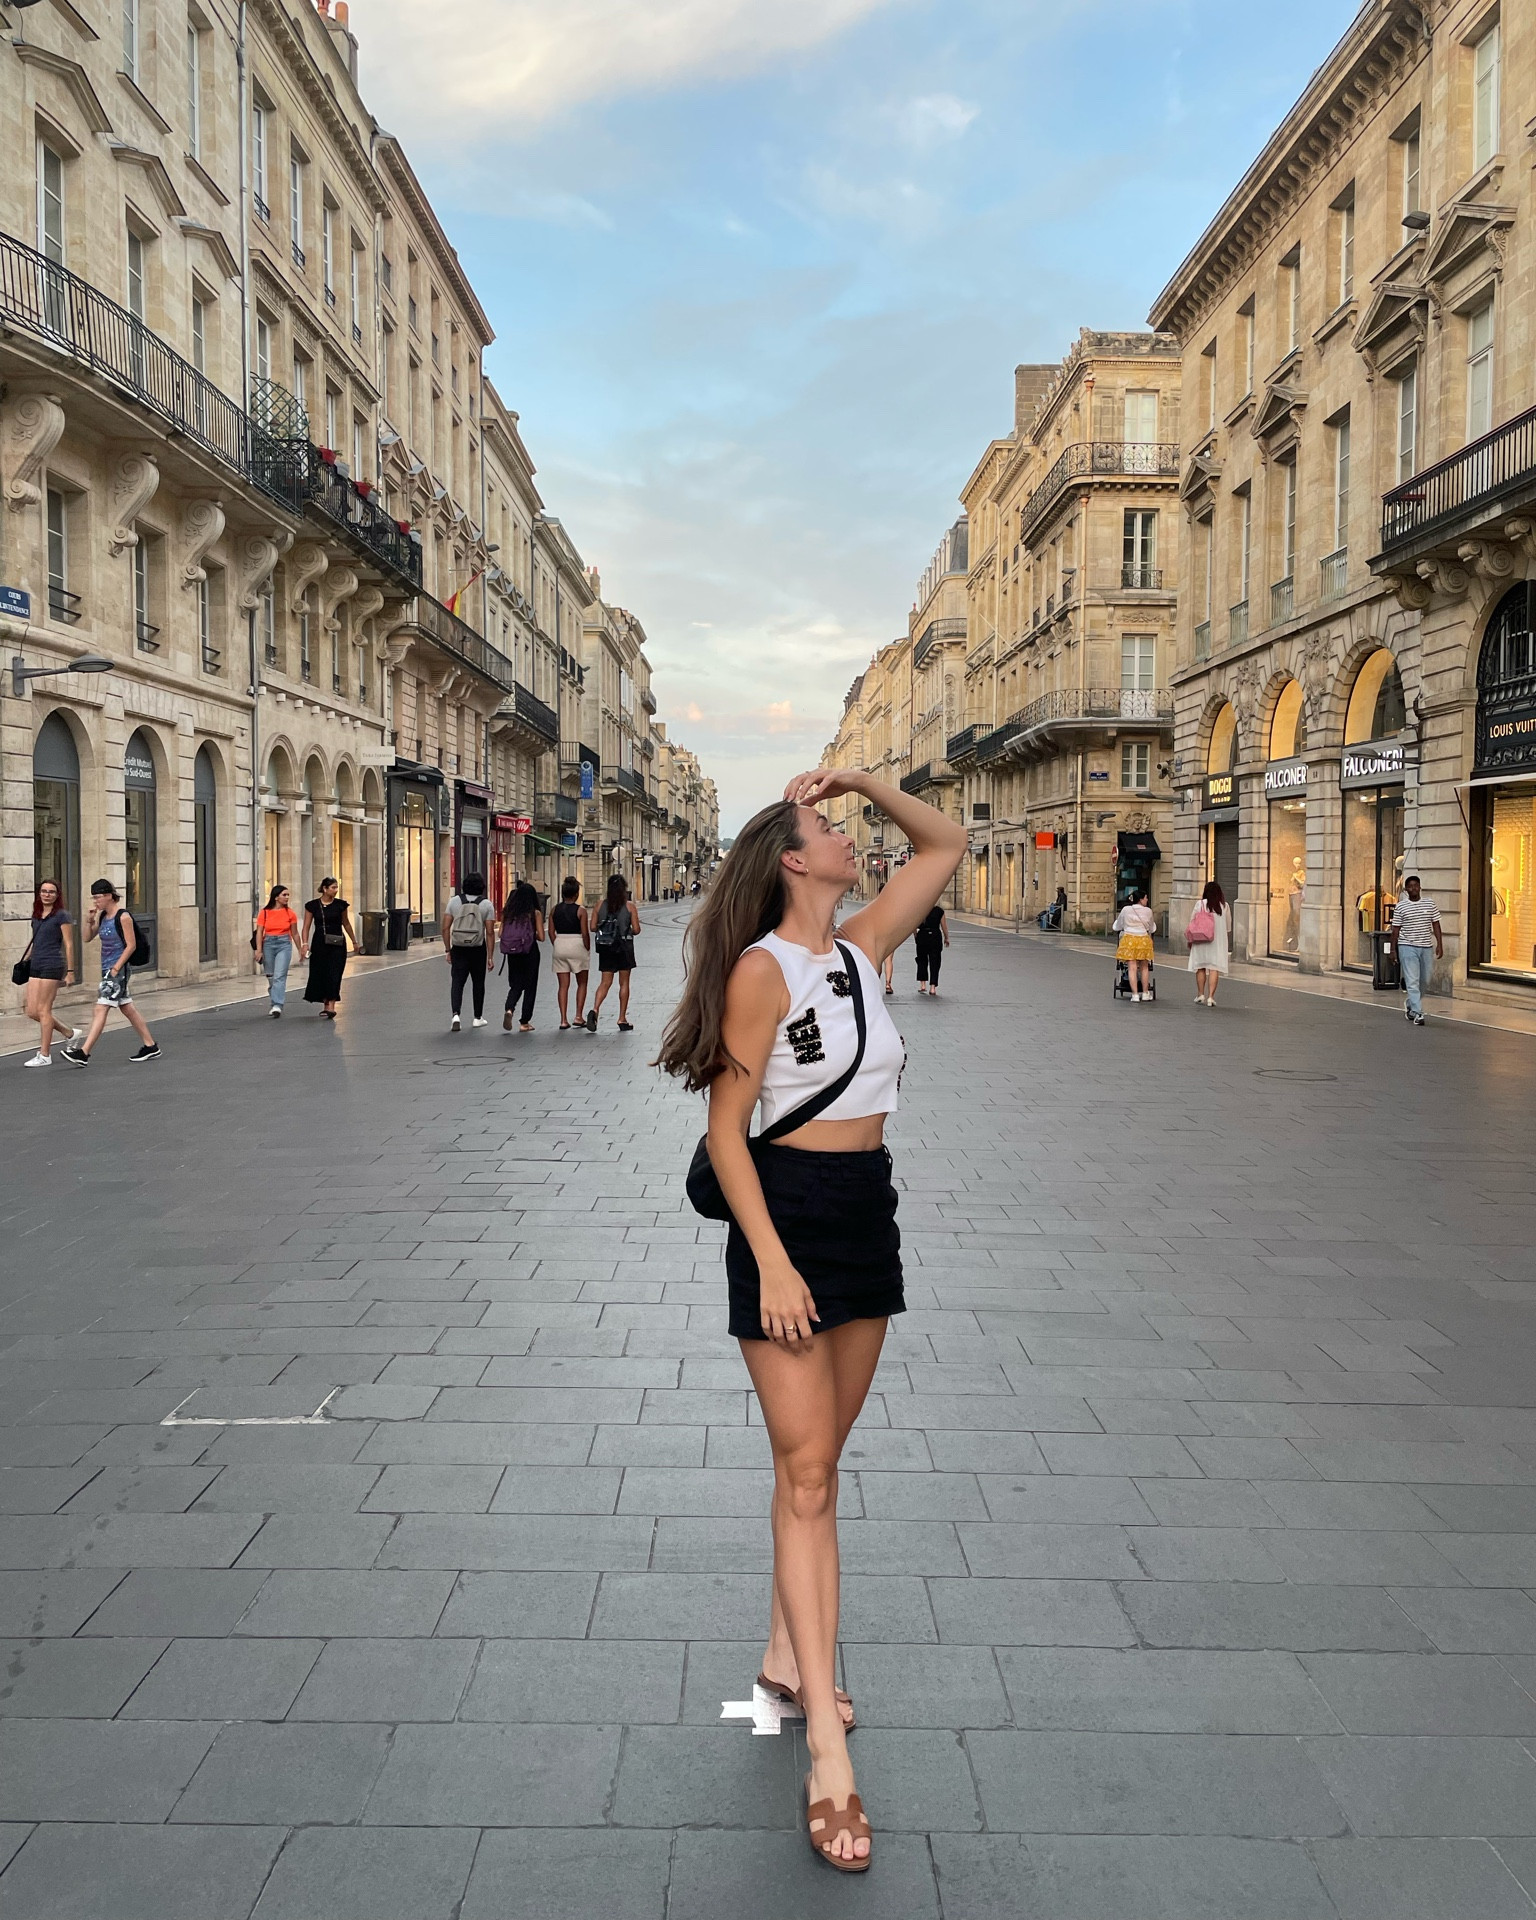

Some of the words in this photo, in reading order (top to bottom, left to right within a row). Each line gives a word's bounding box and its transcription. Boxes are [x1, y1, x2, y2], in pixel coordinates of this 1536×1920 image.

[8, 591, 21, 601] COURS
[1490, 722, 1513, 739] LOUIS
[1343, 748, 1402, 778] FALCONERI
[1265, 764, 1308, 789] FALCONER
[517, 820, 529, 832] illy
